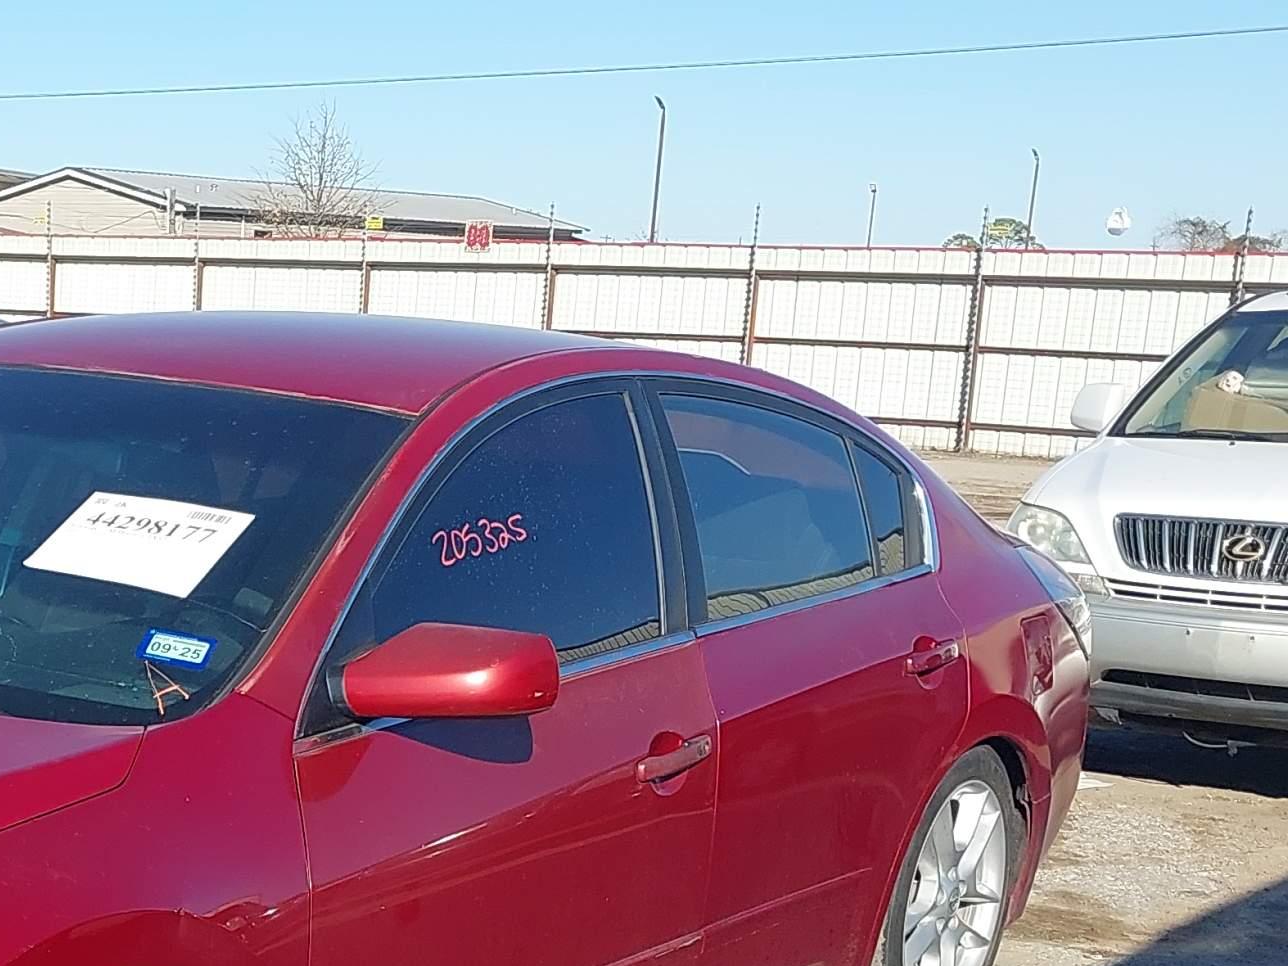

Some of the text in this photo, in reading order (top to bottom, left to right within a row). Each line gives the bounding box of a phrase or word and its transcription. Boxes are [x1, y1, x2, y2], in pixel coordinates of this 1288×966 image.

[86, 512, 218, 543] 44298177
[432, 513, 528, 566] 205325
[150, 641, 203, 660] 09 25
